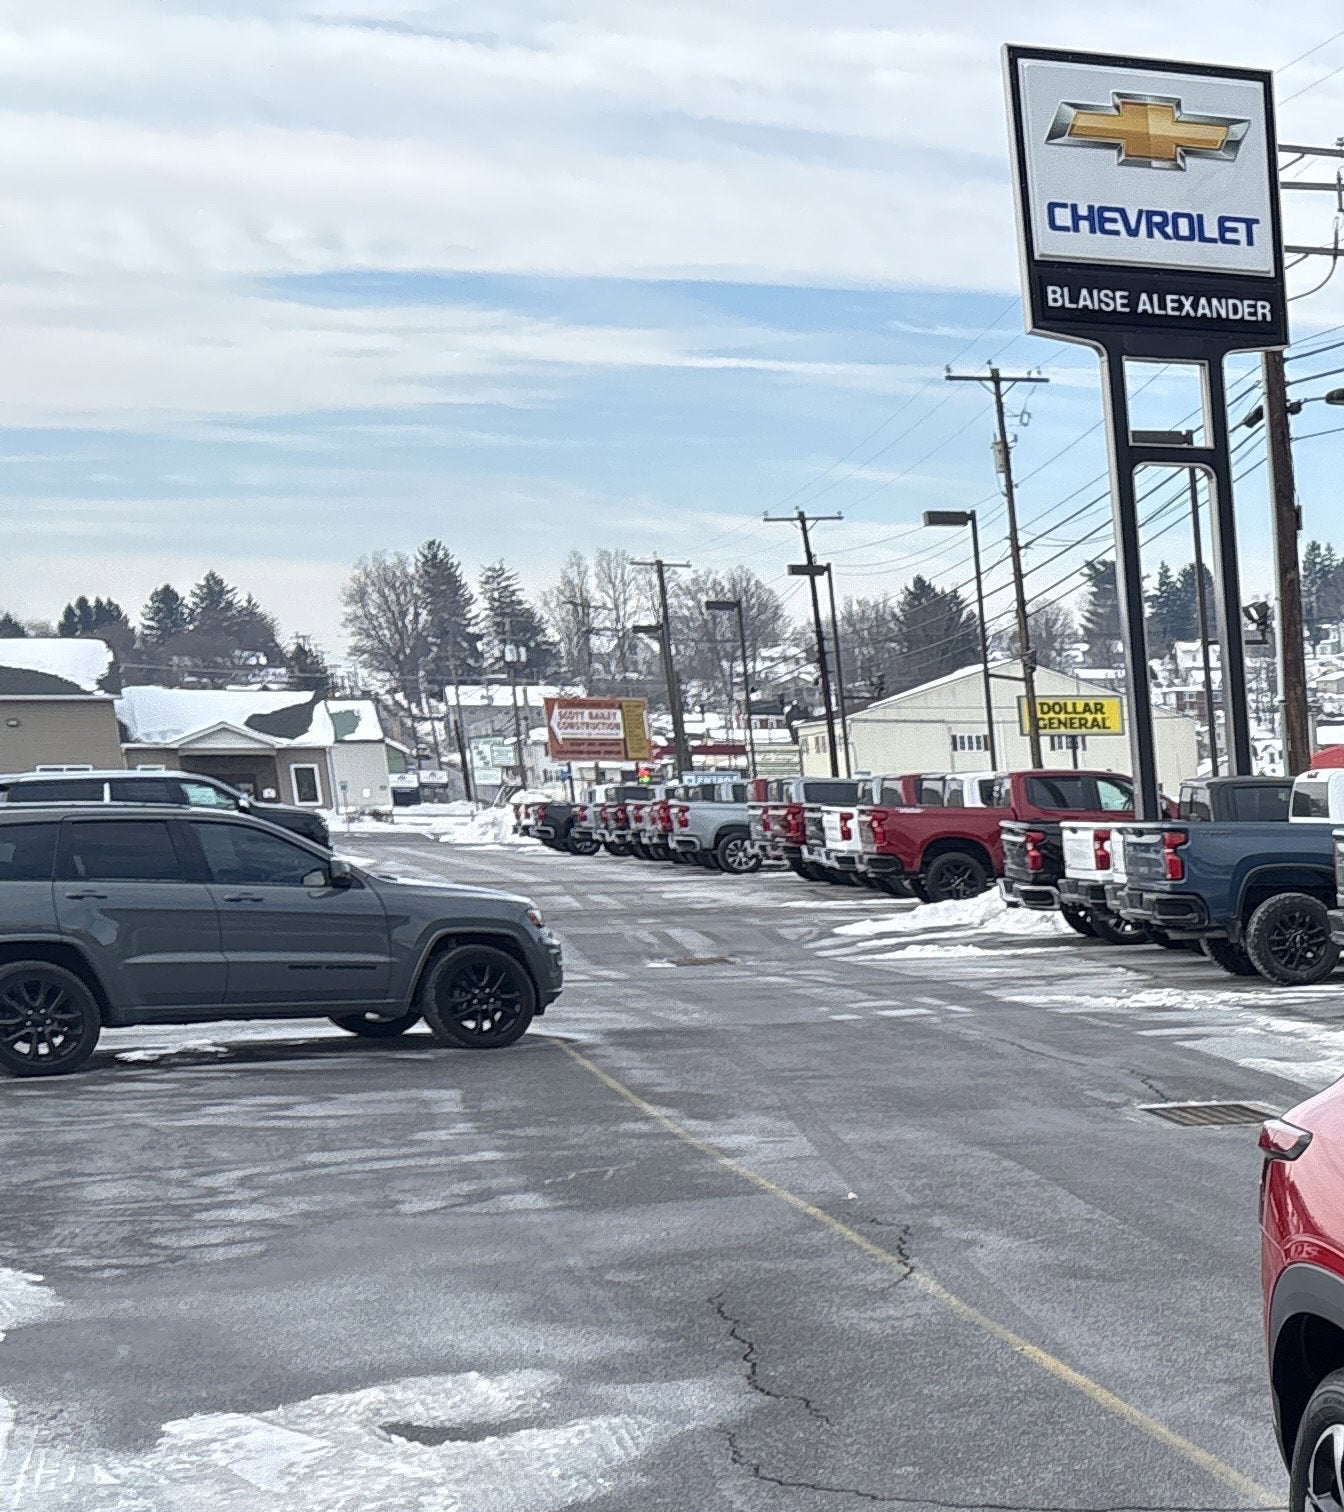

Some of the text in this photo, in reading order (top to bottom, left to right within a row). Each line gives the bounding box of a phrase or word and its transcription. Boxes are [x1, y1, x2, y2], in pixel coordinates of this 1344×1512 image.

[1046, 201, 1260, 247] CHEVROLET
[1046, 285, 1272, 322] BLAISE ALEXANDER
[1038, 702, 1106, 715] DOLLAR
[1037, 717, 1112, 729] GENERAL
